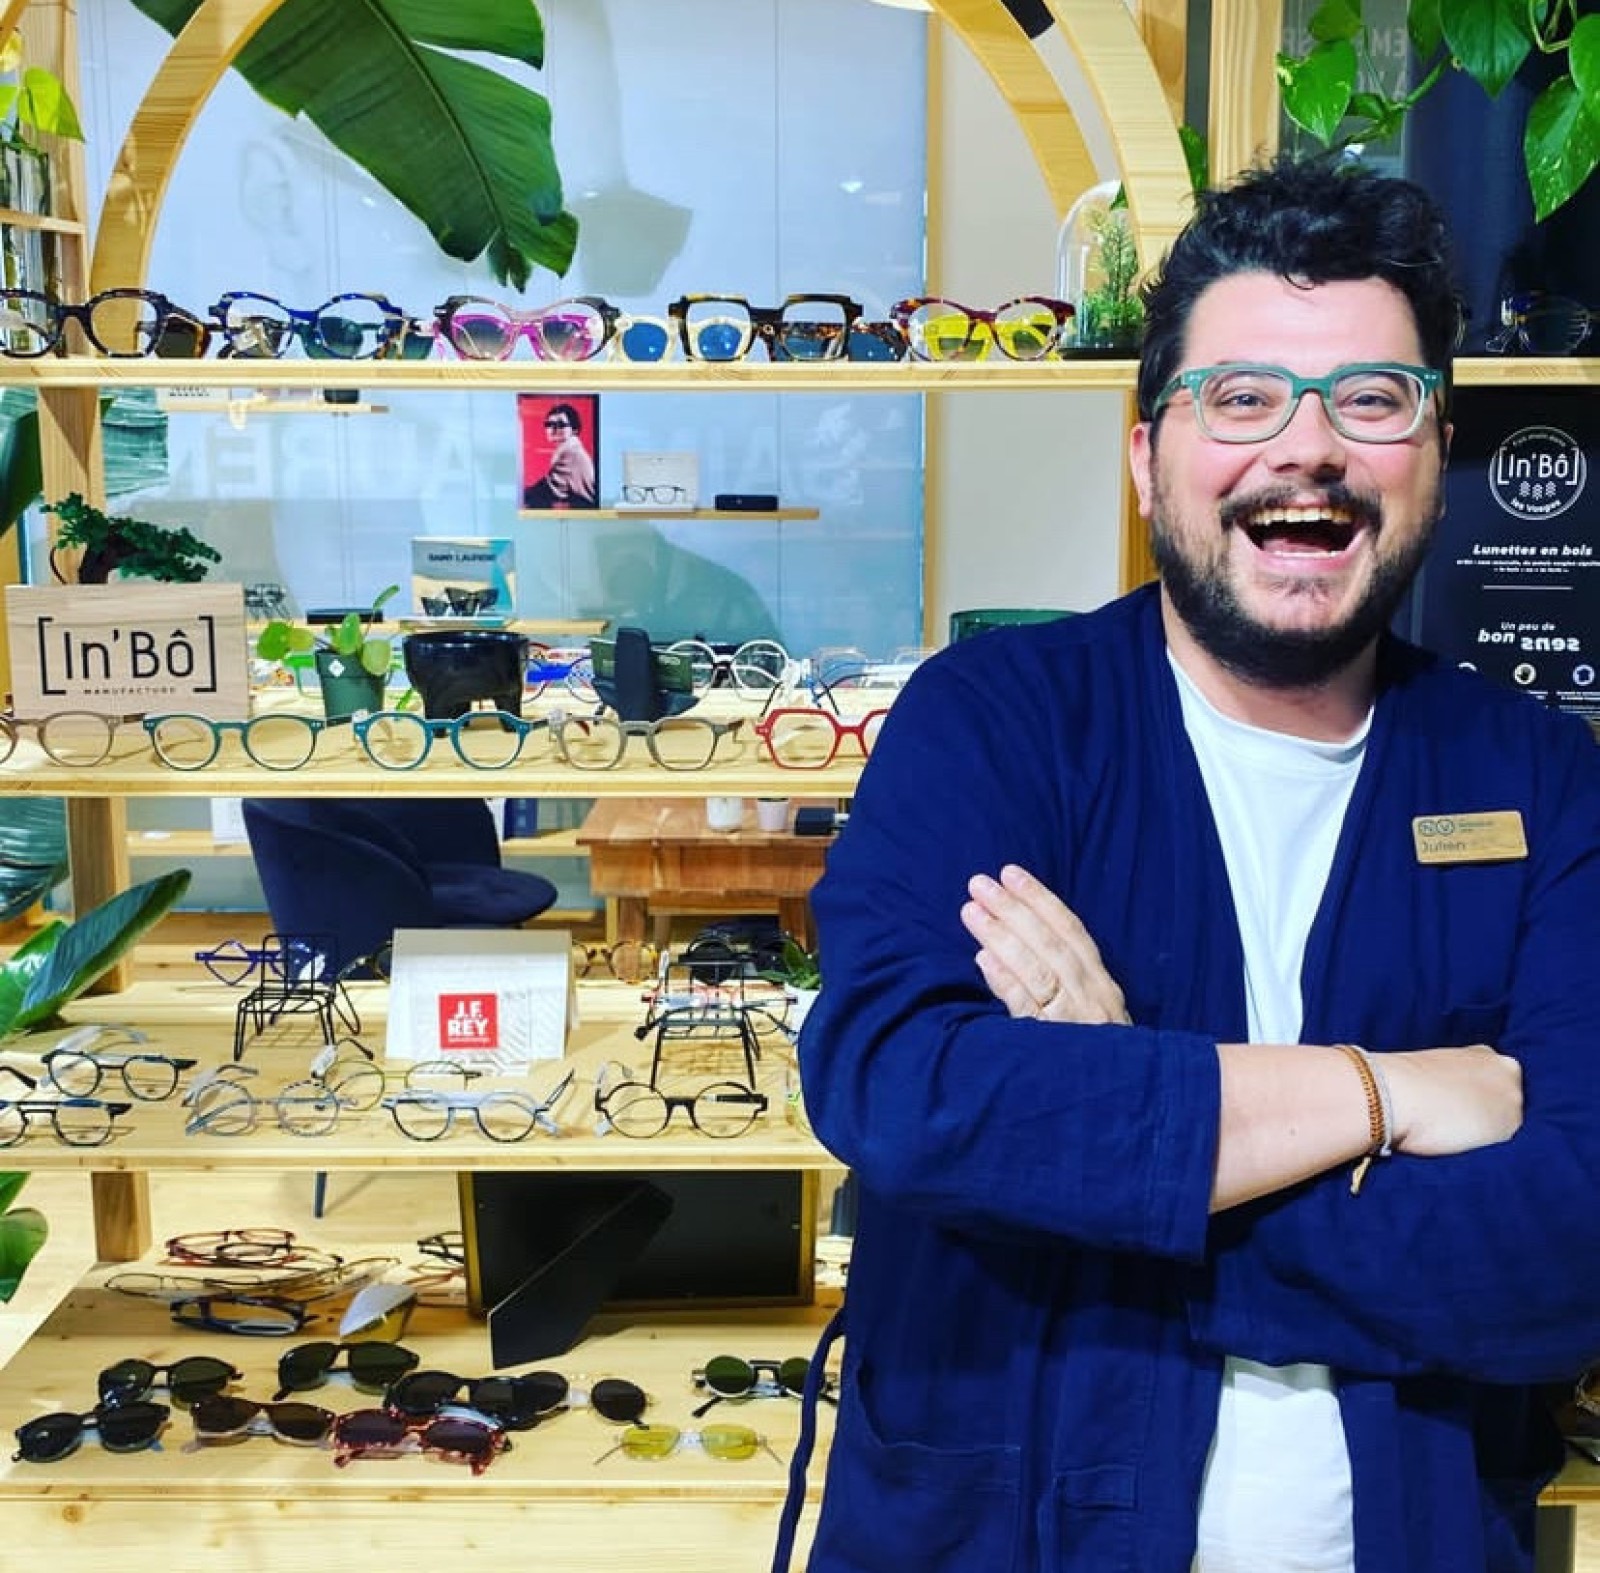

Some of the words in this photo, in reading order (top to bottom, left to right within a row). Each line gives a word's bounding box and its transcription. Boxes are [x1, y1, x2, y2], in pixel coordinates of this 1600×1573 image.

[1473, 545, 1537, 555] Lunettes
[1540, 547, 1558, 555] en
[1562, 545, 1593, 556] bois
[1501, 621, 1516, 631] Un
[1518, 623, 1539, 632] peu
[1541, 621, 1555, 631] de
[1478, 628, 1515, 643] bon
[84, 686, 176, 696] MANUFACTURE
[447, 1018, 488, 1036] REY
